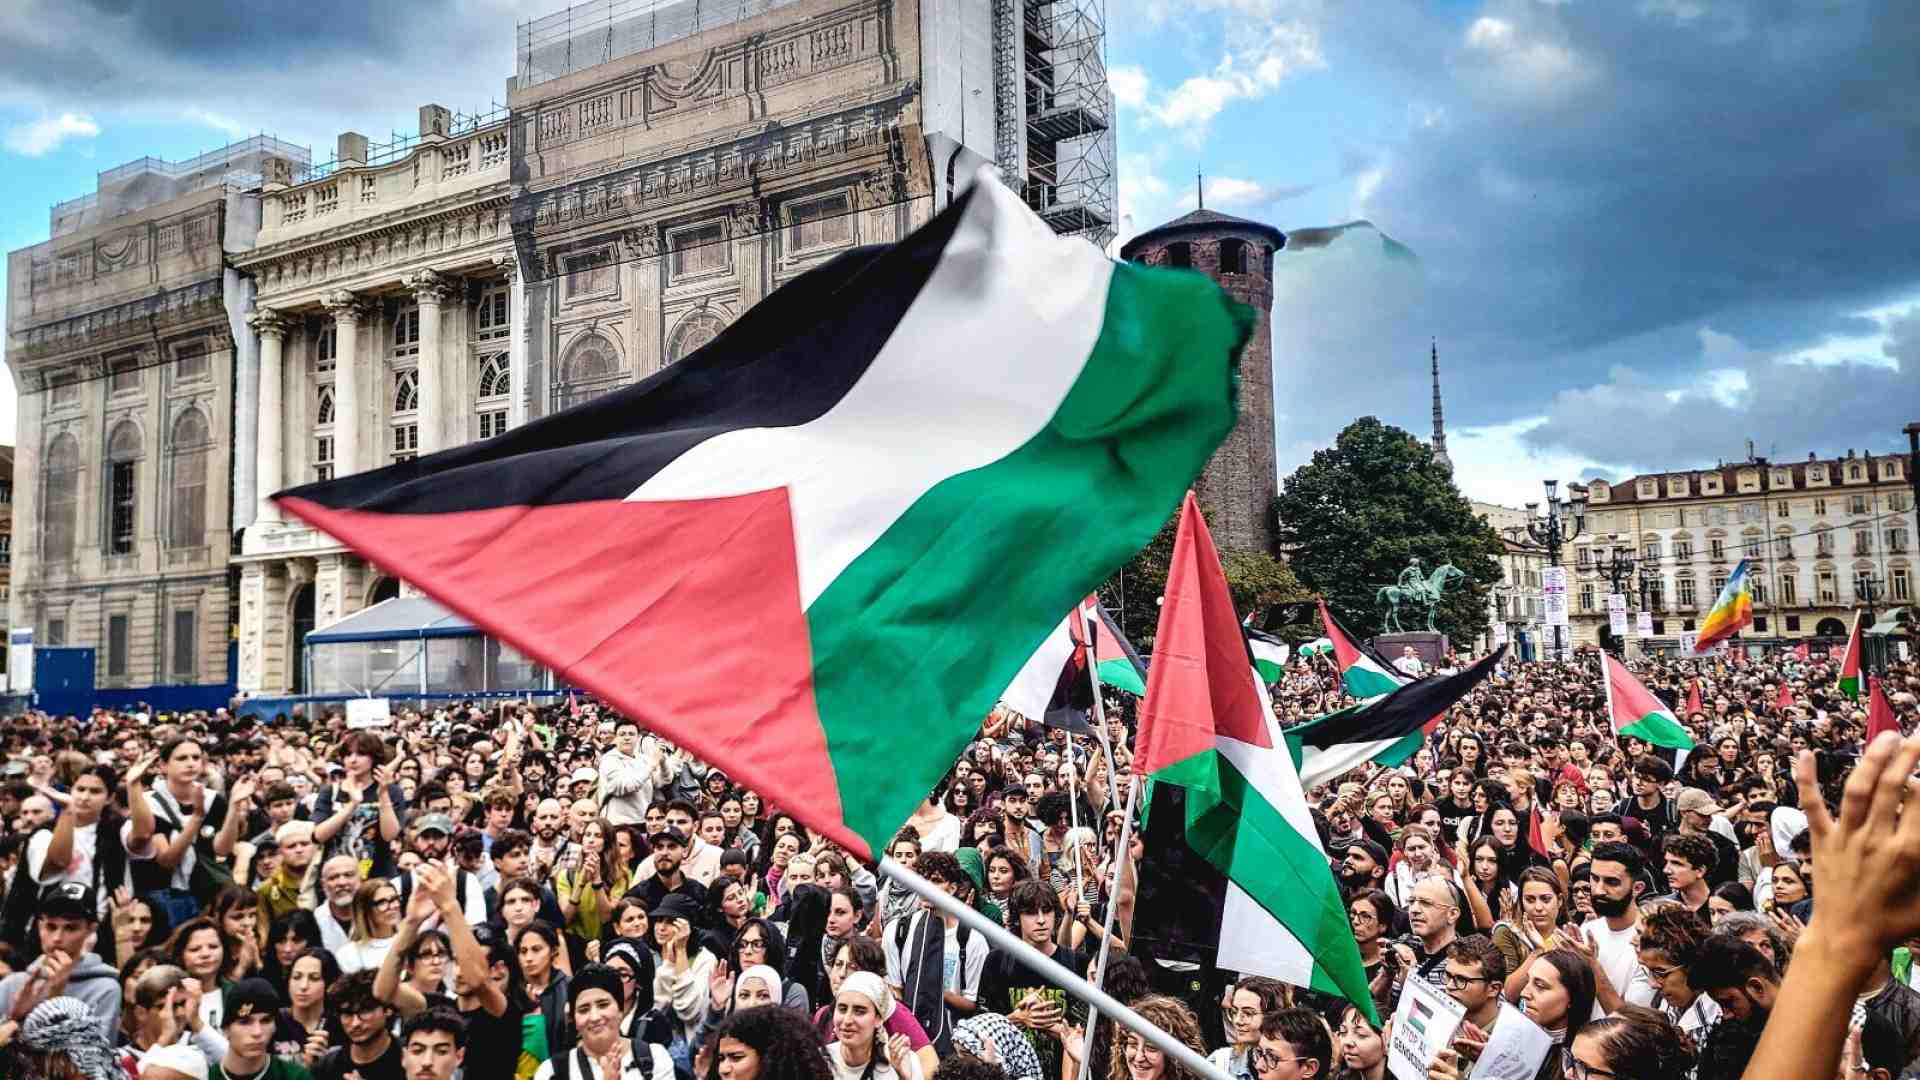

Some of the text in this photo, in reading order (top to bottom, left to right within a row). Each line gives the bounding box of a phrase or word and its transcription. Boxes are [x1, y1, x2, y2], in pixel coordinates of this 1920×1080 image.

[1443, 816, 1460, 826] adi
[1393, 1036, 1426, 1077] GENOCIDI
[1402, 1023, 1426, 1057] STOP AL
